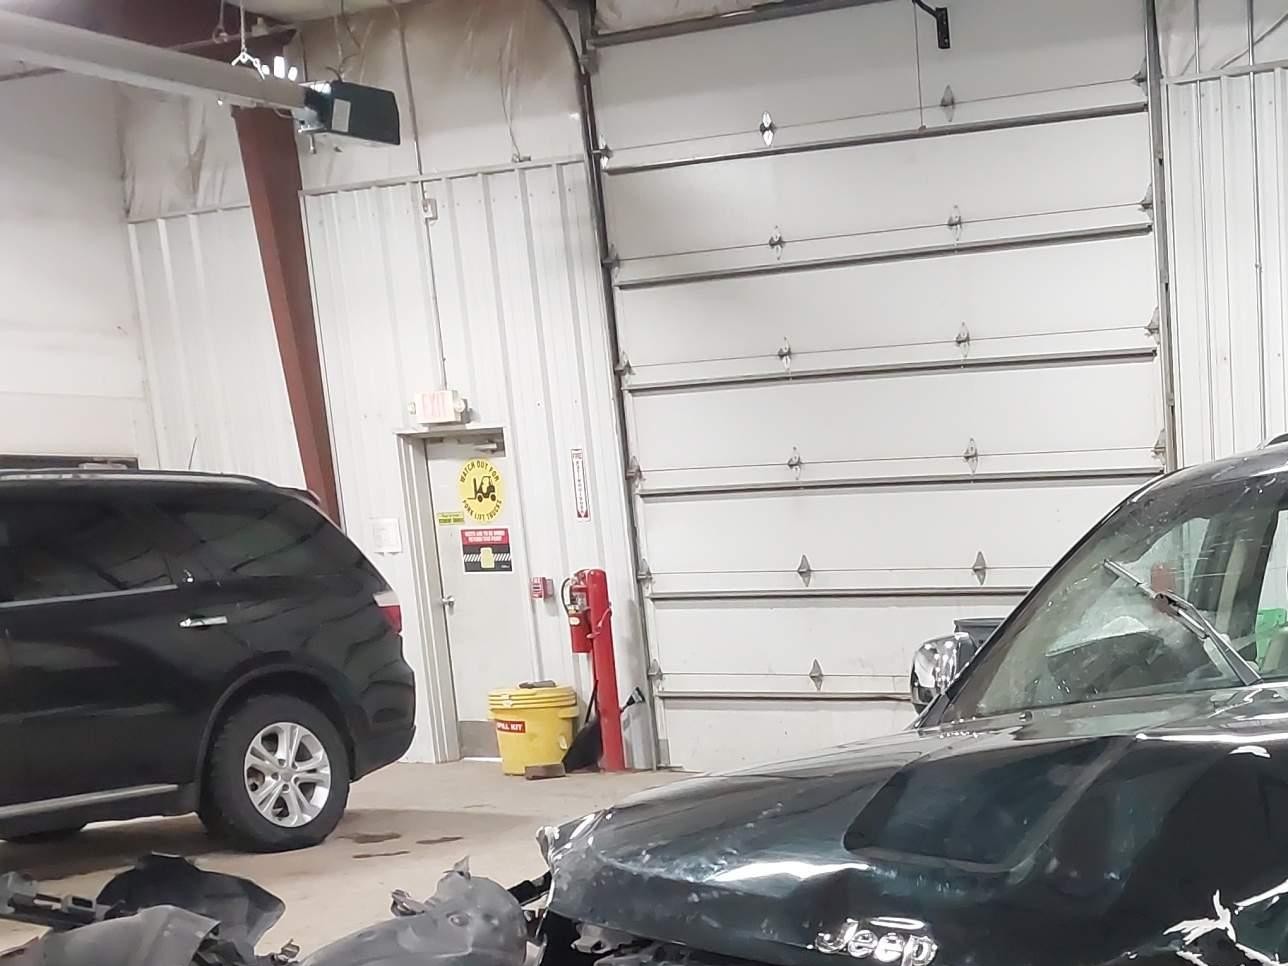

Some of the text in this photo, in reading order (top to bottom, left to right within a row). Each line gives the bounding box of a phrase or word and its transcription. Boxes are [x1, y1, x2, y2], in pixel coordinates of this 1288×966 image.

[460, 460, 500, 483] WATCH OUT FOR
[462, 499, 474, 517] FORK
[511, 723, 523, 731] KIT
